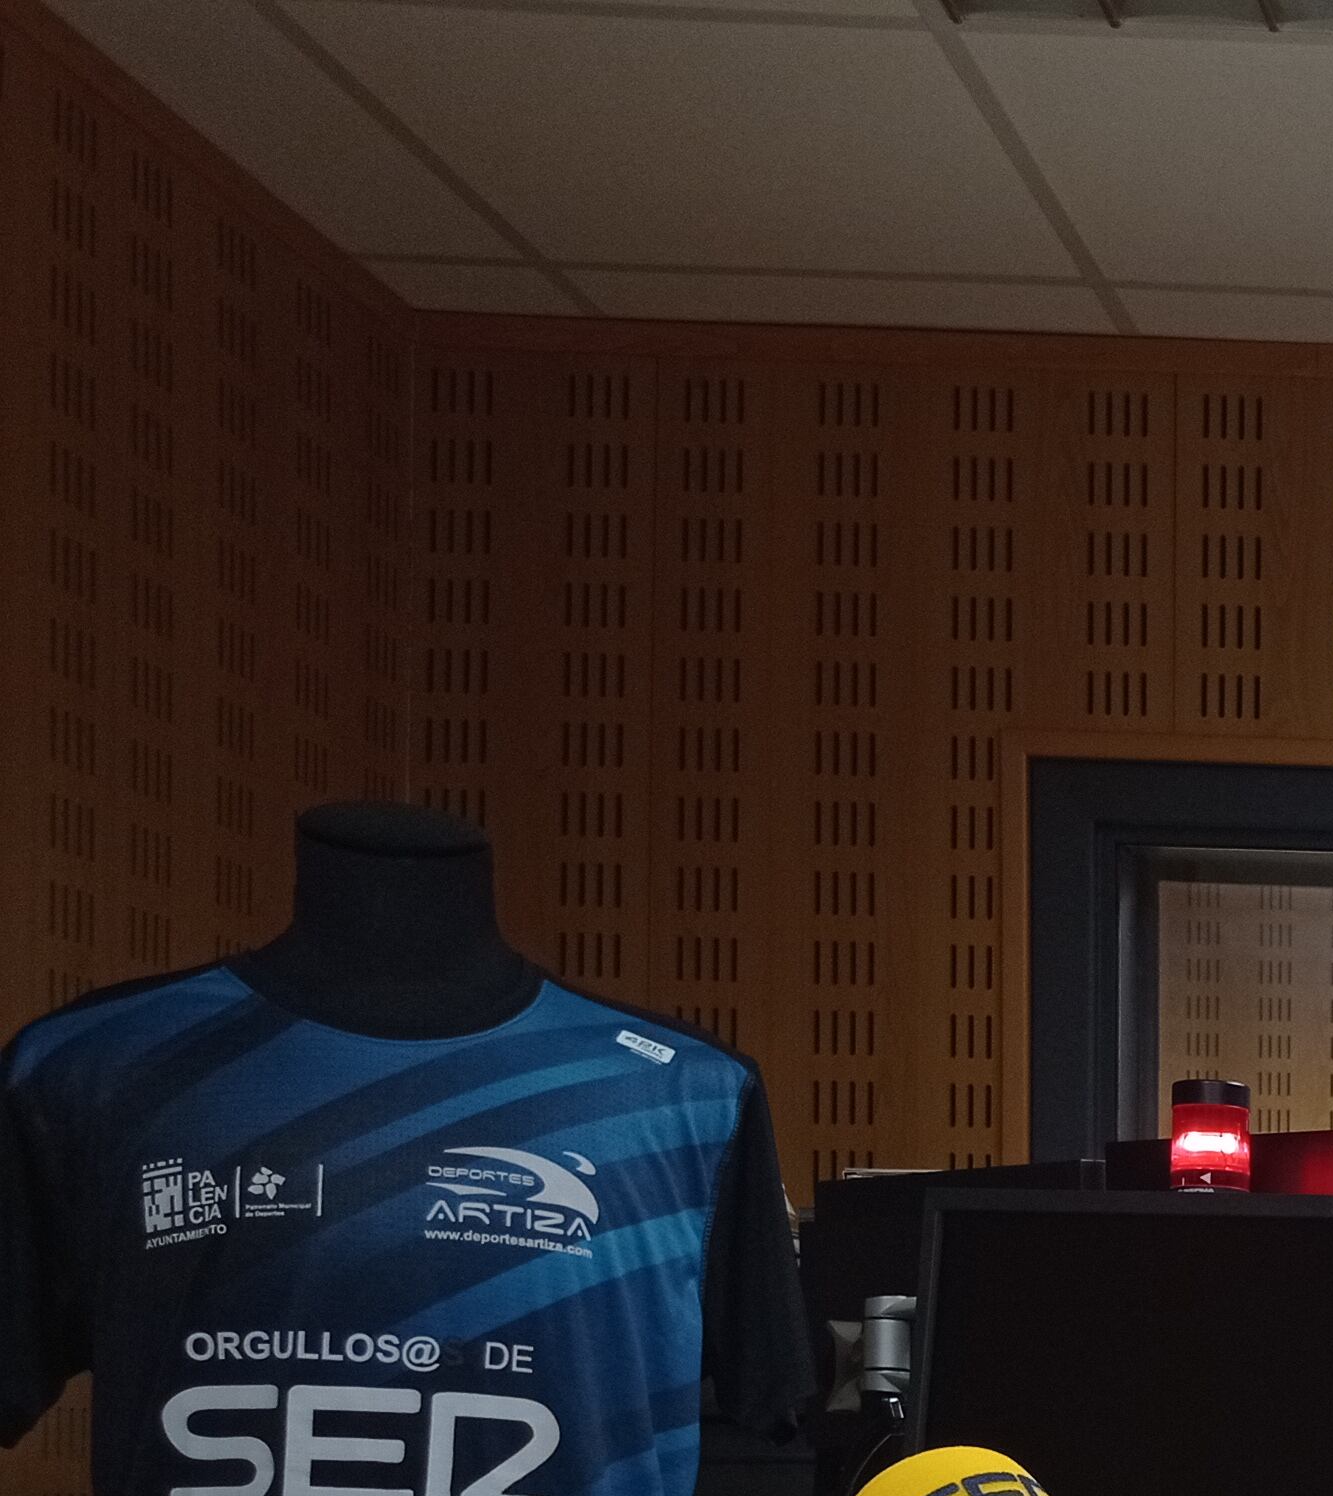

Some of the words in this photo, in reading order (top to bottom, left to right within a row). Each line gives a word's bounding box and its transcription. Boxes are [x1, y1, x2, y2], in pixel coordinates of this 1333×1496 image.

[188, 1170, 216, 1190] PA
[428, 1166, 535, 1187] DEPORTES
[188, 1184, 228, 1207] LEN
[189, 1204, 222, 1224] CIA
[426, 1200, 592, 1242] ARTIZA
[145, 1223, 228, 1250] AYUNTAMIENTO
[424, 1230, 593, 1259] www.deportesartiza.com
[184, 1330, 441, 1373] ORGULLOS@
[484, 1341, 535, 1374] DE
